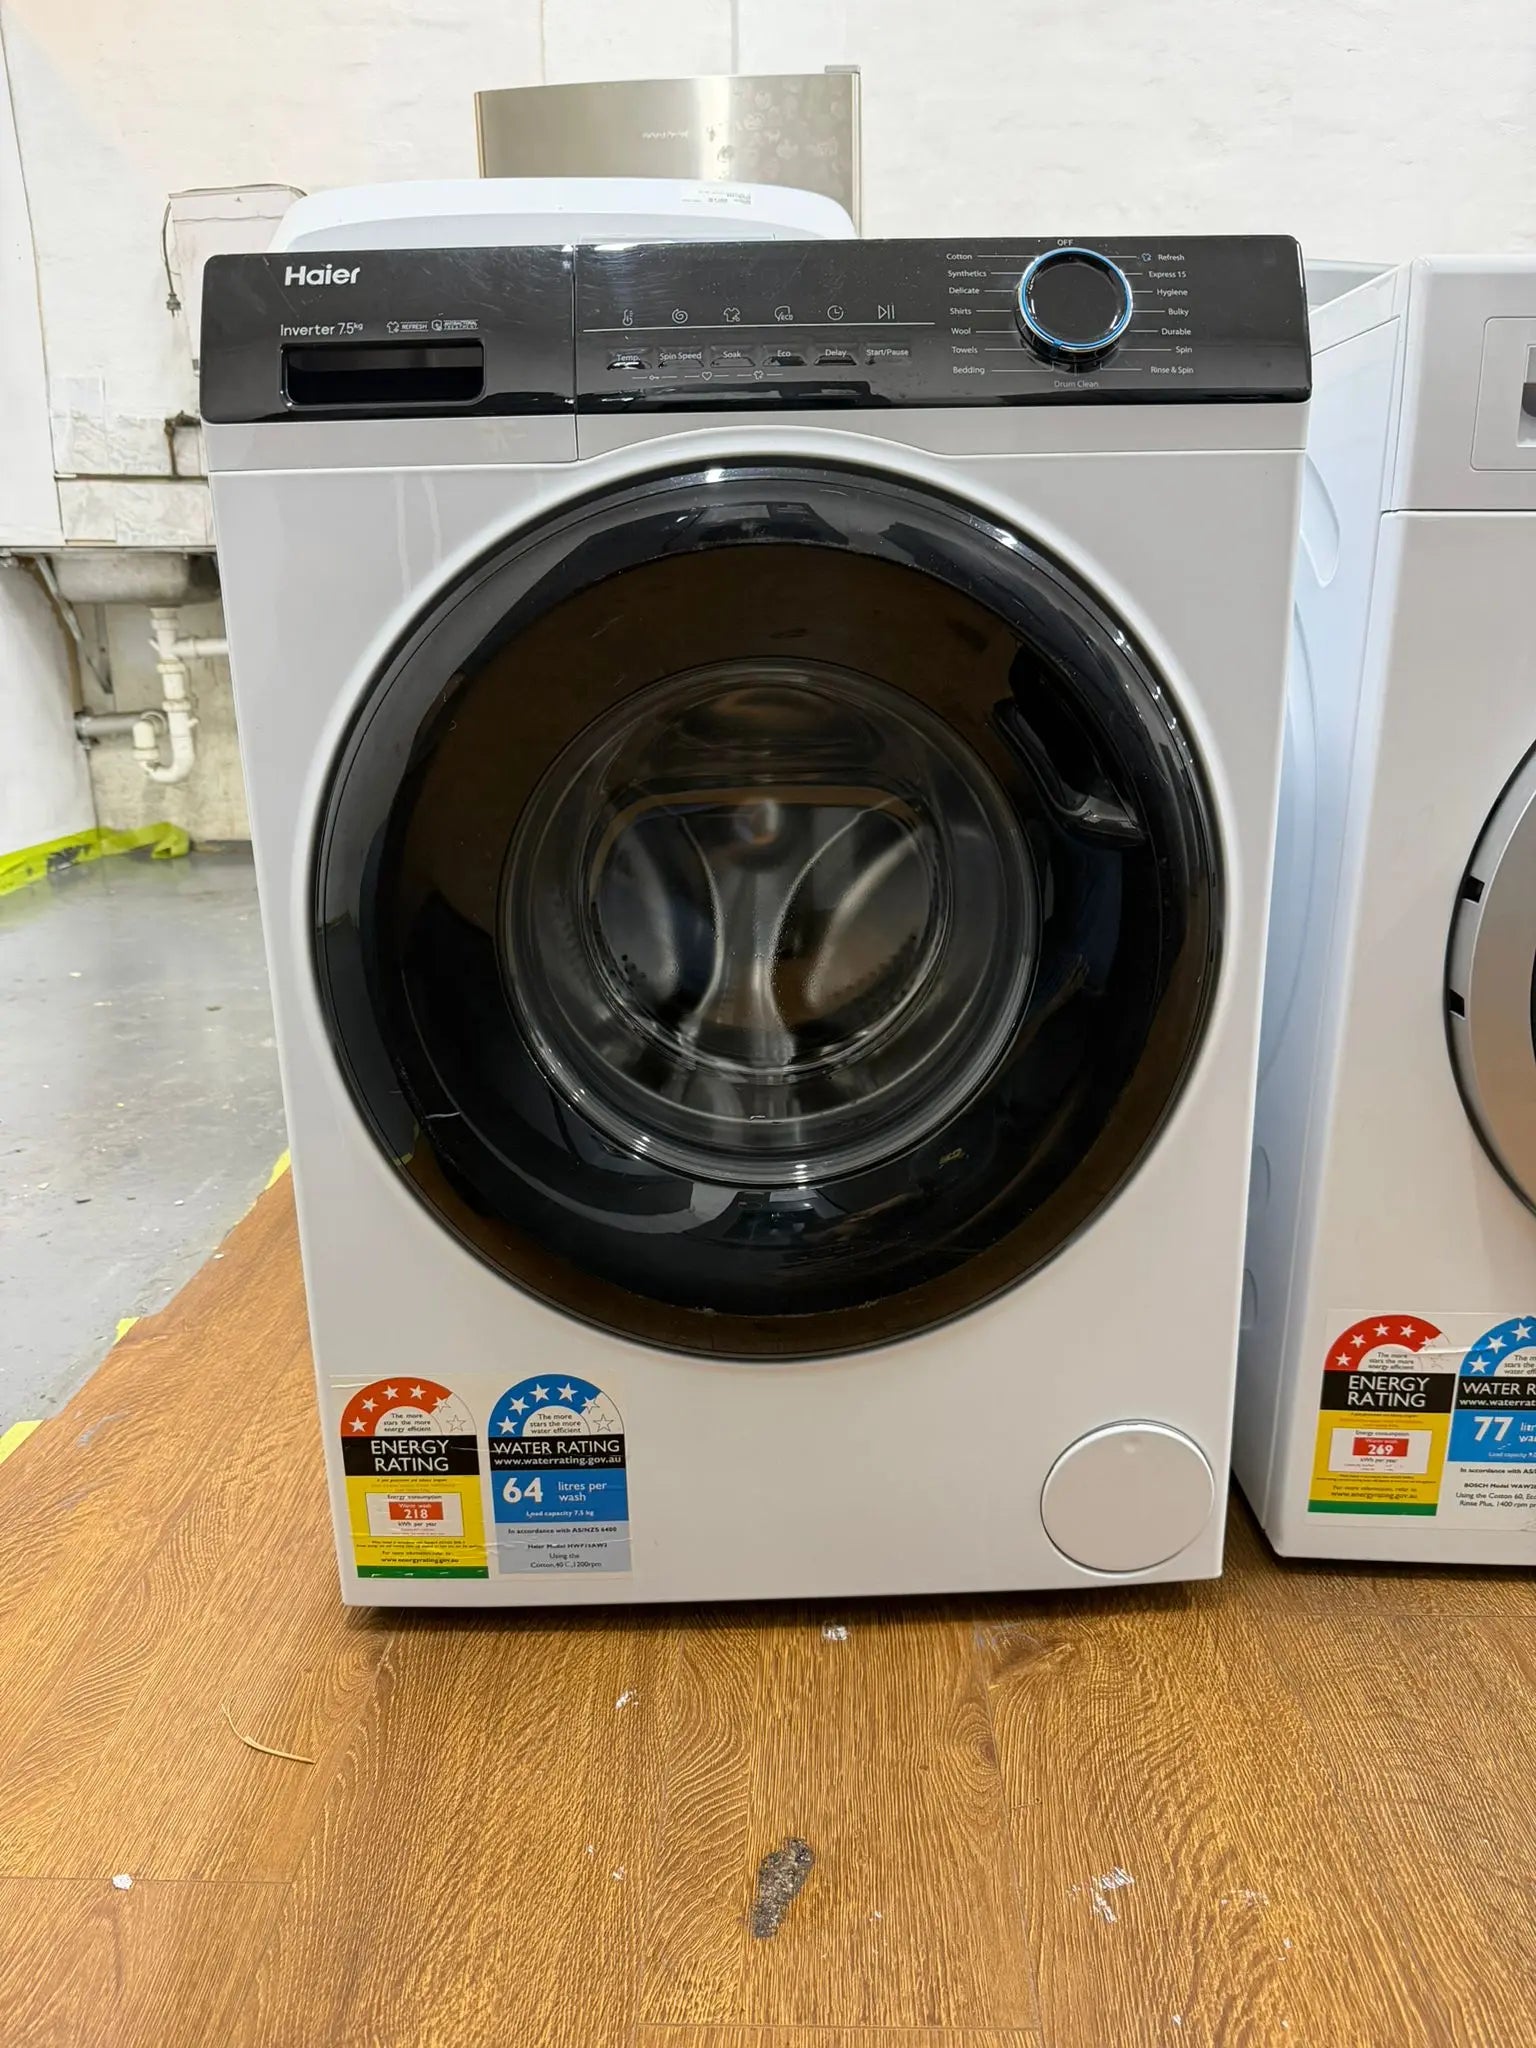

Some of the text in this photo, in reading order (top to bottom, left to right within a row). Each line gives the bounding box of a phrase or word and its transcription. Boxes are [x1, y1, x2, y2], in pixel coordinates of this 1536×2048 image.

[1057, 238, 1073, 247] OFF
[946, 252, 973, 261] Cotton
[1158, 253, 1185, 262] Refresh
[285, 263, 361, 286] Haier
[947, 269, 987, 279] Synthetics
[1149, 270, 1187, 280] Express 15
[949, 286, 980, 295] Delicate
[1156, 288, 1189, 298] Hygiene
[950, 307, 972, 316] Shirts
[1168, 307, 1189, 317] Bulky
[280, 323, 335, 337] Inverter
[951, 327, 972, 336] Wool
[1161, 327, 1192, 336] Durable
[723, 350, 742, 359] Soak
[777, 349, 792, 358] Eco
[825, 348, 847, 358] Delay
[866, 348, 909, 357] Start/Pause
[951, 345, 978, 354] Towels
[1175, 345, 1193, 355] Spin
[616, 353, 641, 363] Temp.
[659, 352, 702, 362] Spin Speed
[952, 366, 986, 376] Bedding
[1150, 366, 1194, 376] Rinse & Spin
[1054, 379, 1099, 389] Drum Clean
[1348, 1375, 1430, 1391] ENERGY
[1462, 1382, 1521, 1396] WATER
[1347, 1390, 1427, 1408] RATING
[1474, 1415, 1515, 1442] 77
[370, 1439, 450, 1455] ENERGY
[493, 1439, 621, 1455] WATER RATING
[1367, 1443, 1394, 1456] 269
[374, 1456, 450, 1472] RATING
[493, 1455, 622, 1467] www.waterrating.gov.au
[502, 1476, 544, 1503] 64
[557, 1481, 608, 1493] litres per
[558, 1491, 587, 1502] wash
[403, 1508, 429, 1519] 218
